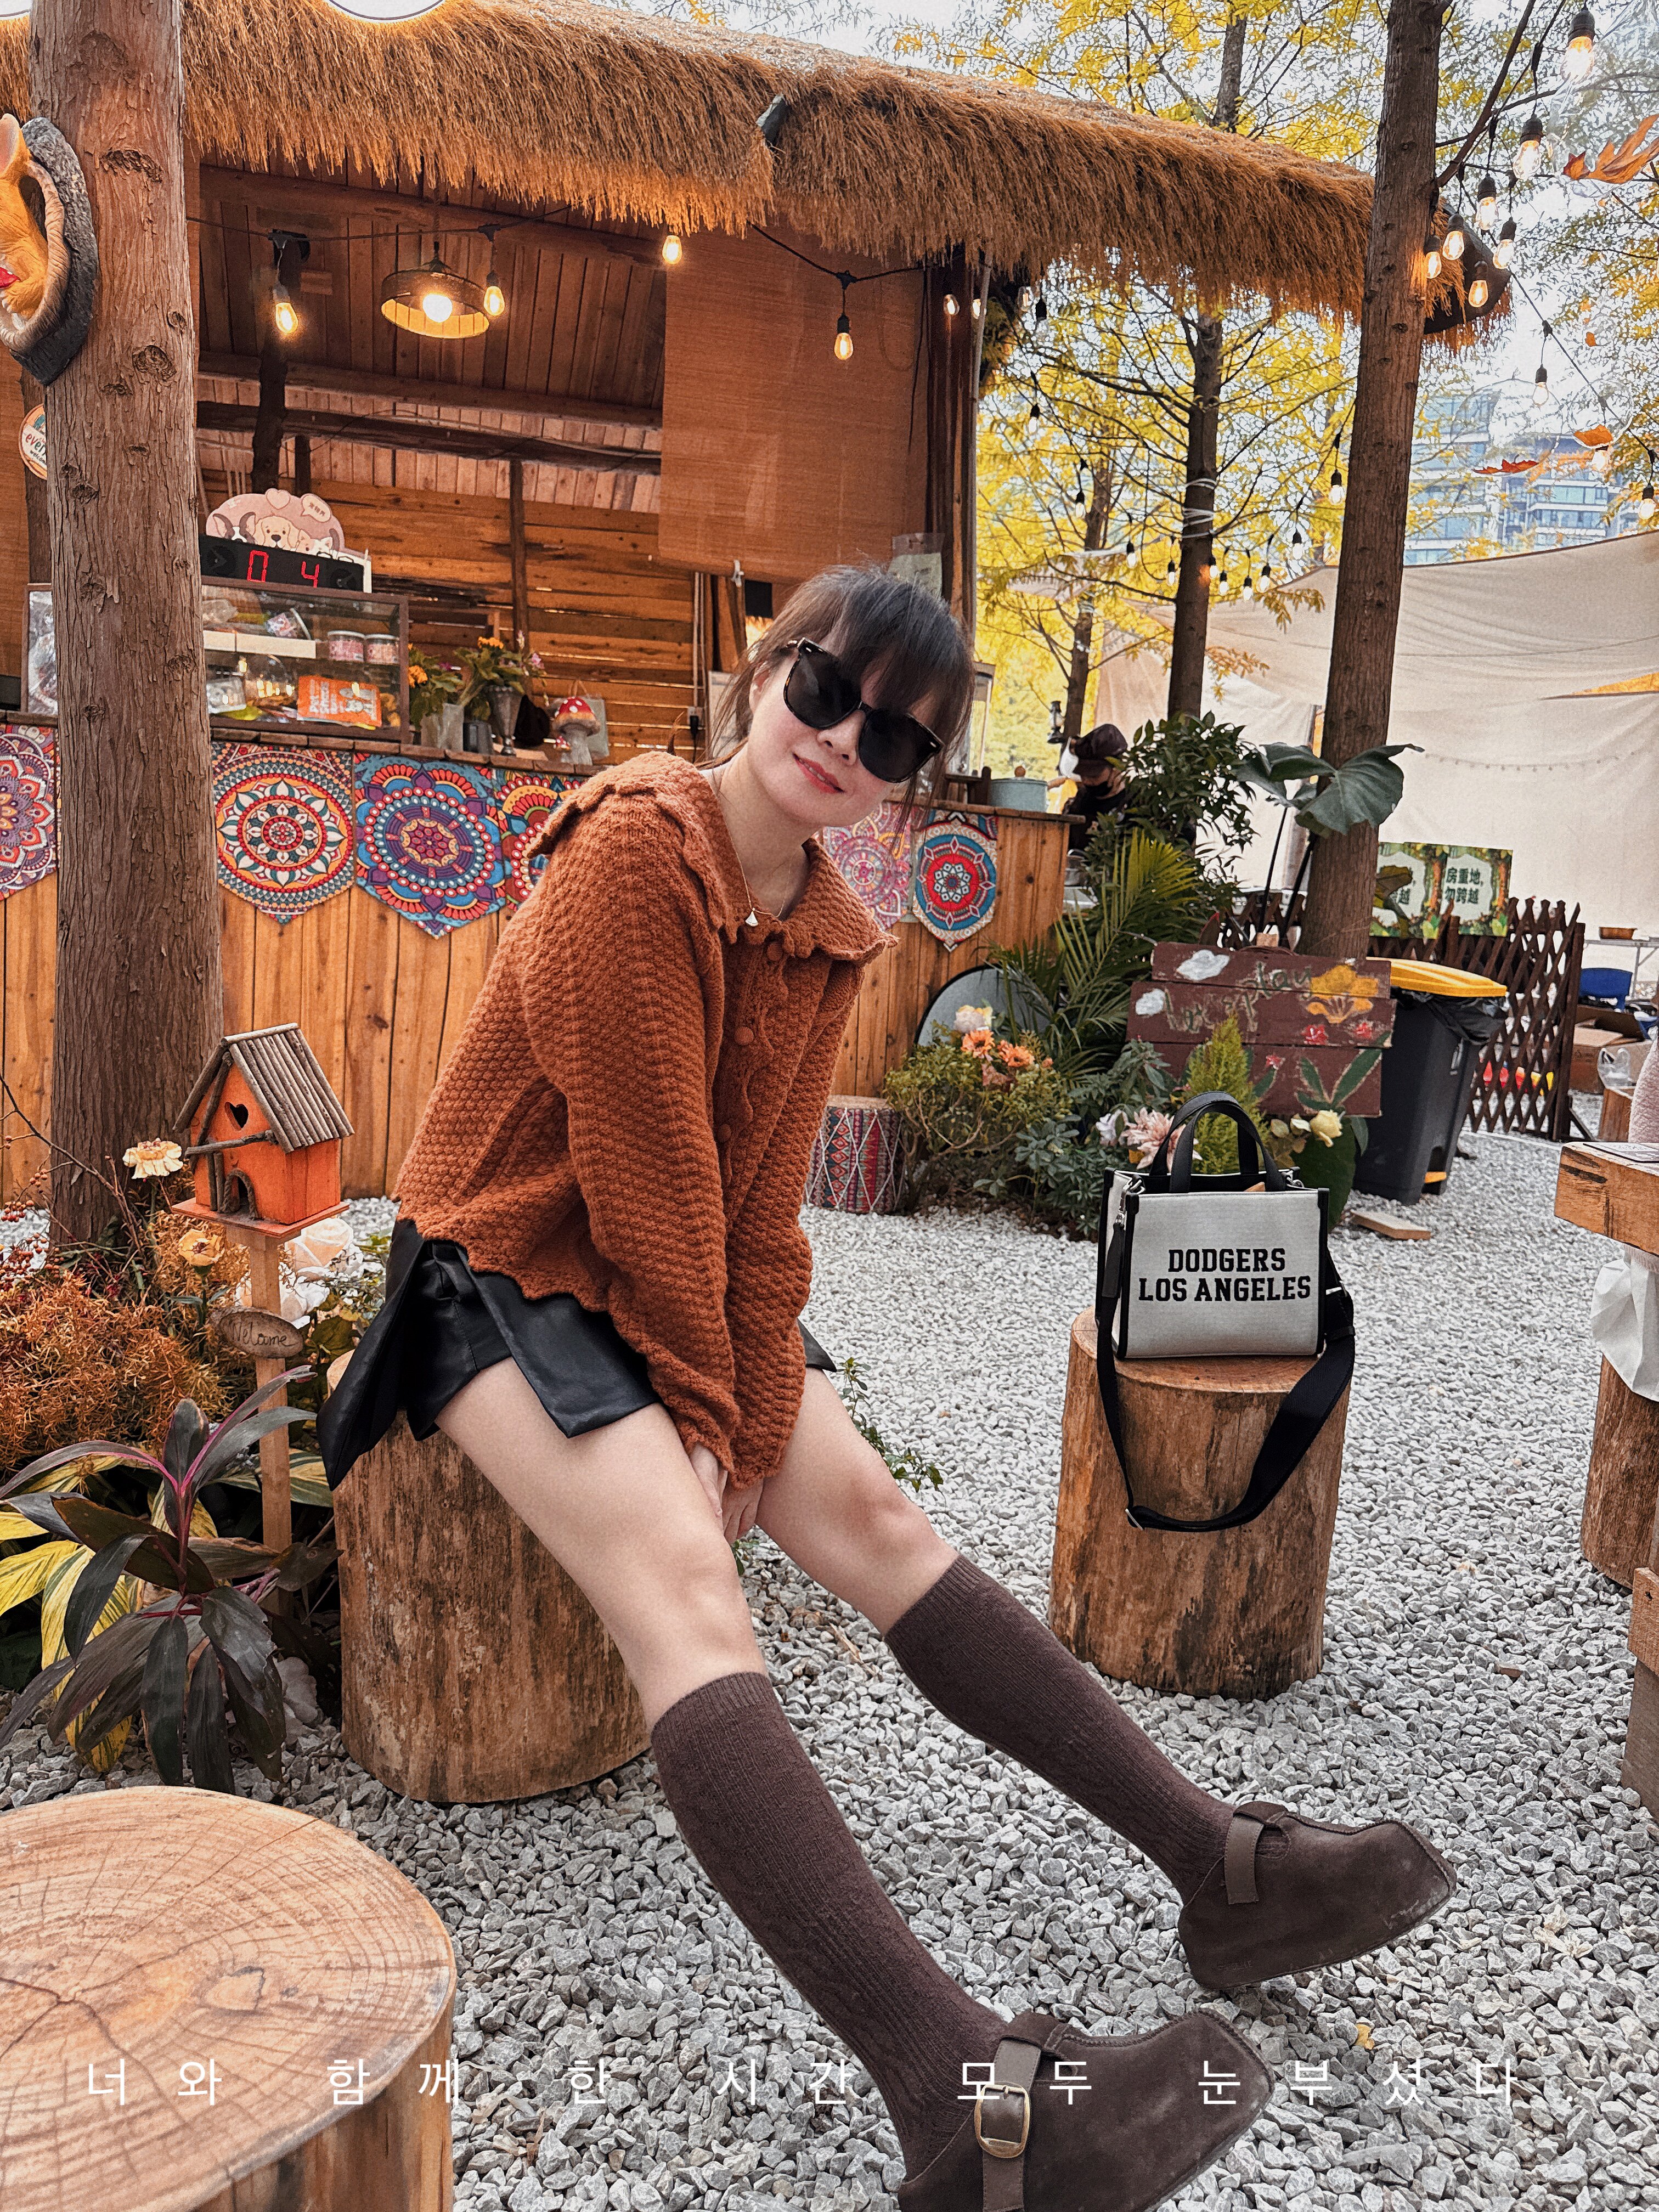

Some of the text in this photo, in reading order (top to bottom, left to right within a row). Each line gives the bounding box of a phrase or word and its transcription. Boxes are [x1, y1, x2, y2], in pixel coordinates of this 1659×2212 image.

[301, 561, 320, 588] 4
[1168, 1248, 1285, 1272] DODGERS
[1138, 1275, 1311, 1302] LOS ANGELES
